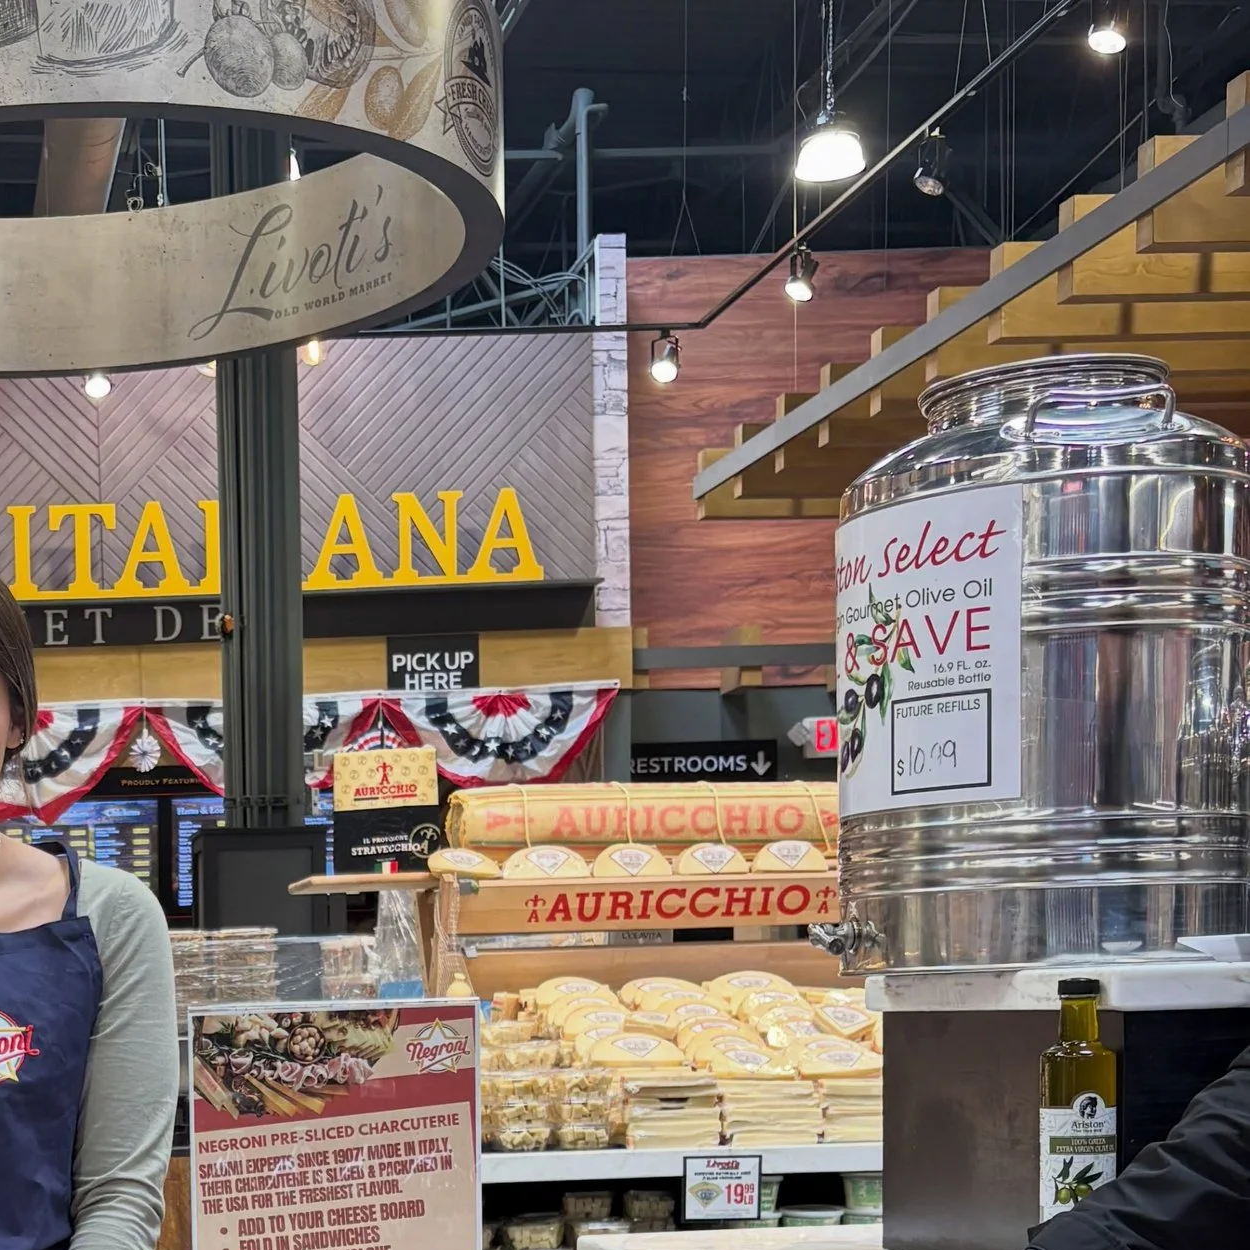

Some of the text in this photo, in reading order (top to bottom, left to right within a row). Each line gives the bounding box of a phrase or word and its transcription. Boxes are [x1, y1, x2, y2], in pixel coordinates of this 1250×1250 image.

[275, 272, 392, 320] OLD WORLD MARKET
[7, 487, 544, 601] ITAANA
[878, 519, 1006, 579] Select
[845, 593, 901, 624] Gourmet
[906, 586, 955, 609] Olive
[963, 577, 993, 599] Oil
[871, 605, 991, 667] SAVE
[392, 651, 474, 673] PICK UP
[933, 661, 954, 676] 16.9
[404, 671, 463, 690] HERE
[907, 671, 991, 693] Reusable Bottle
[896, 698, 981, 720] FUTURE REFILLS
[163, 777, 200, 785] FEATURI
[354, 784, 417, 797] AURICCHIO
[550, 804, 805, 838] AURICCHIO
[351, 843, 421, 856] STRAVECCHIO
[546, 884, 811, 922] AURICCHIO
[406, 1035, 470, 1067] Negroni
[198, 1113, 460, 1154] NEGRONI PRE-SLICED CHARCUTERIE
[199, 1161, 243, 1179] SALUMI
[246, 1155, 295, 1175] EXPERTS
[297, 1150, 330, 1168] SINCE
[332, 1146, 365, 1165] 1907!
[367, 1142, 402, 1160] MADE
[404, 1140, 416, 1157] IN
[200, 1154, 453, 1197] THEIR CHARCUTERIE IS SLICED & PACKAGED IN
[202, 1179, 403, 1215] THE USA FOR THE FRESHEST FLAVOR.
[238, 1199, 425, 1237] ADD TO YOUR CHEESE BOARD
